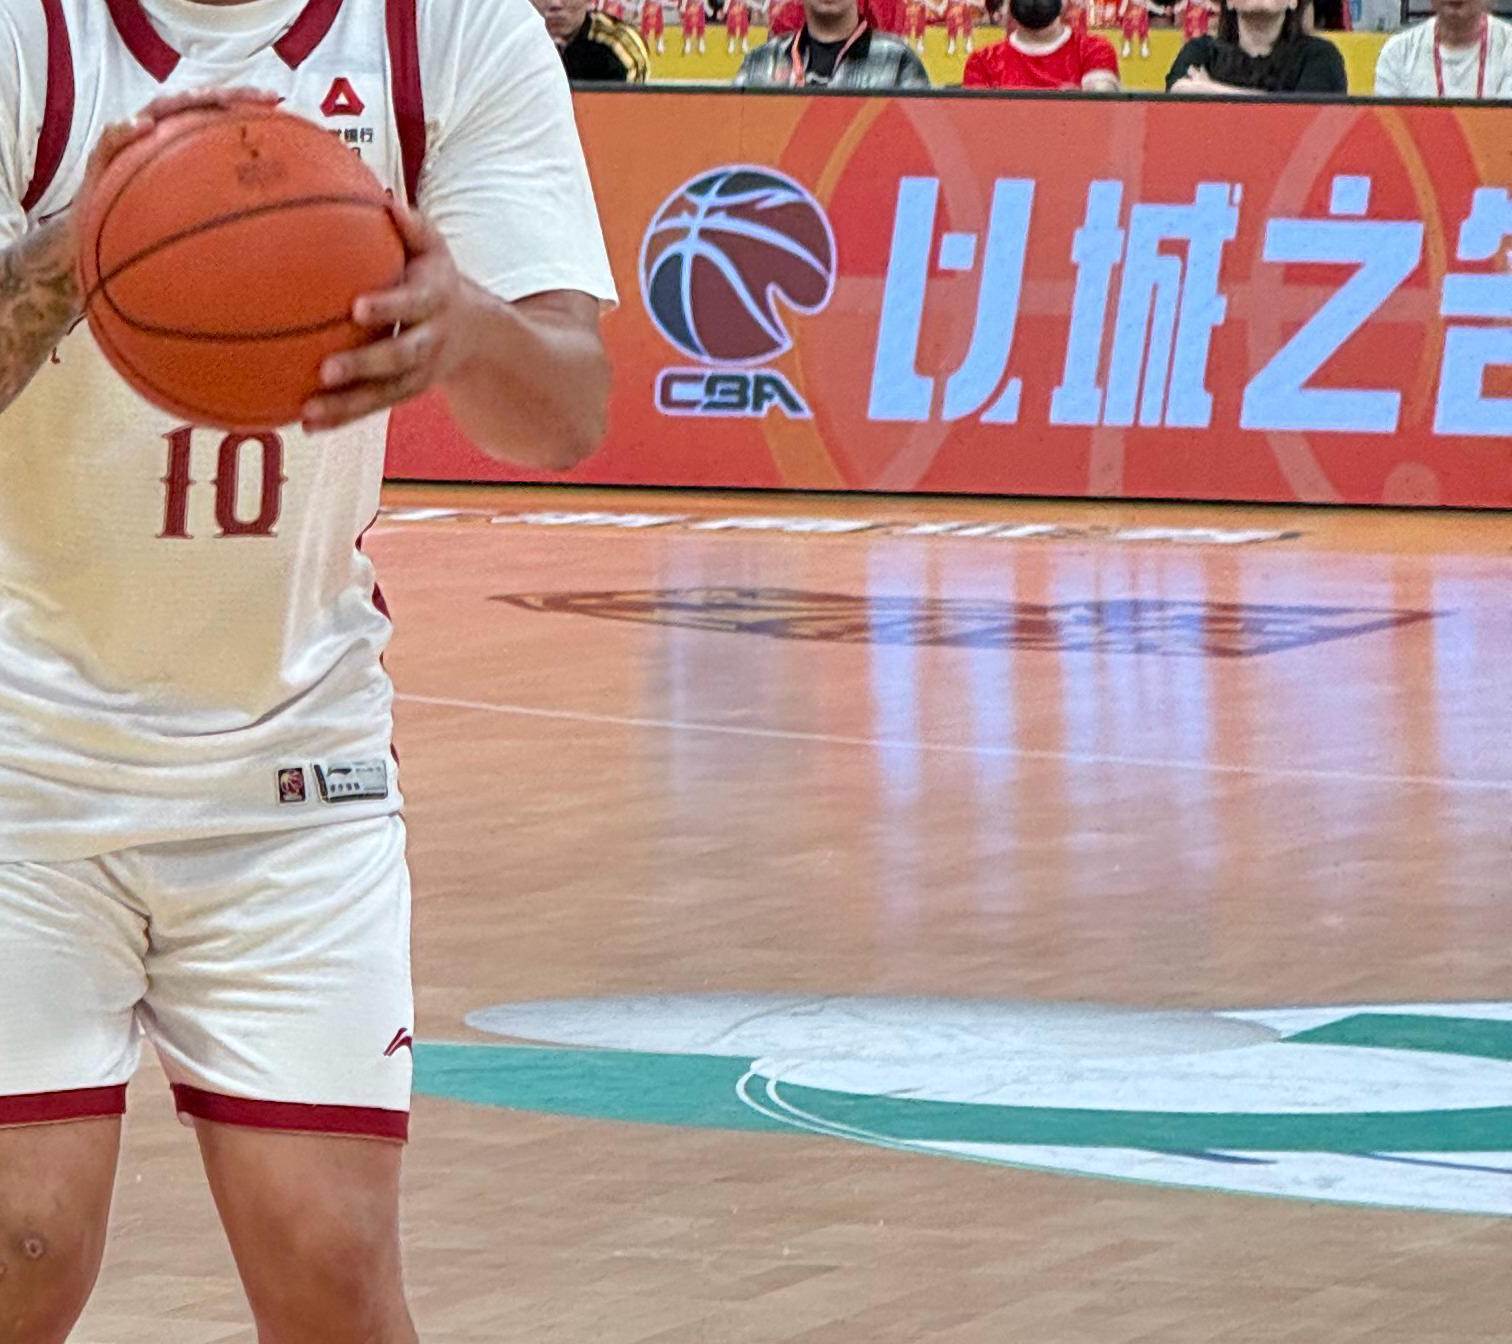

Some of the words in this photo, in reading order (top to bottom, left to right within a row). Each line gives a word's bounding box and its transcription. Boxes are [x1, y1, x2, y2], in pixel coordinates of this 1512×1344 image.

[336, 127, 374, 144] 银行
[656, 368, 813, 419] CBA
[155, 423, 288, 540] 10
